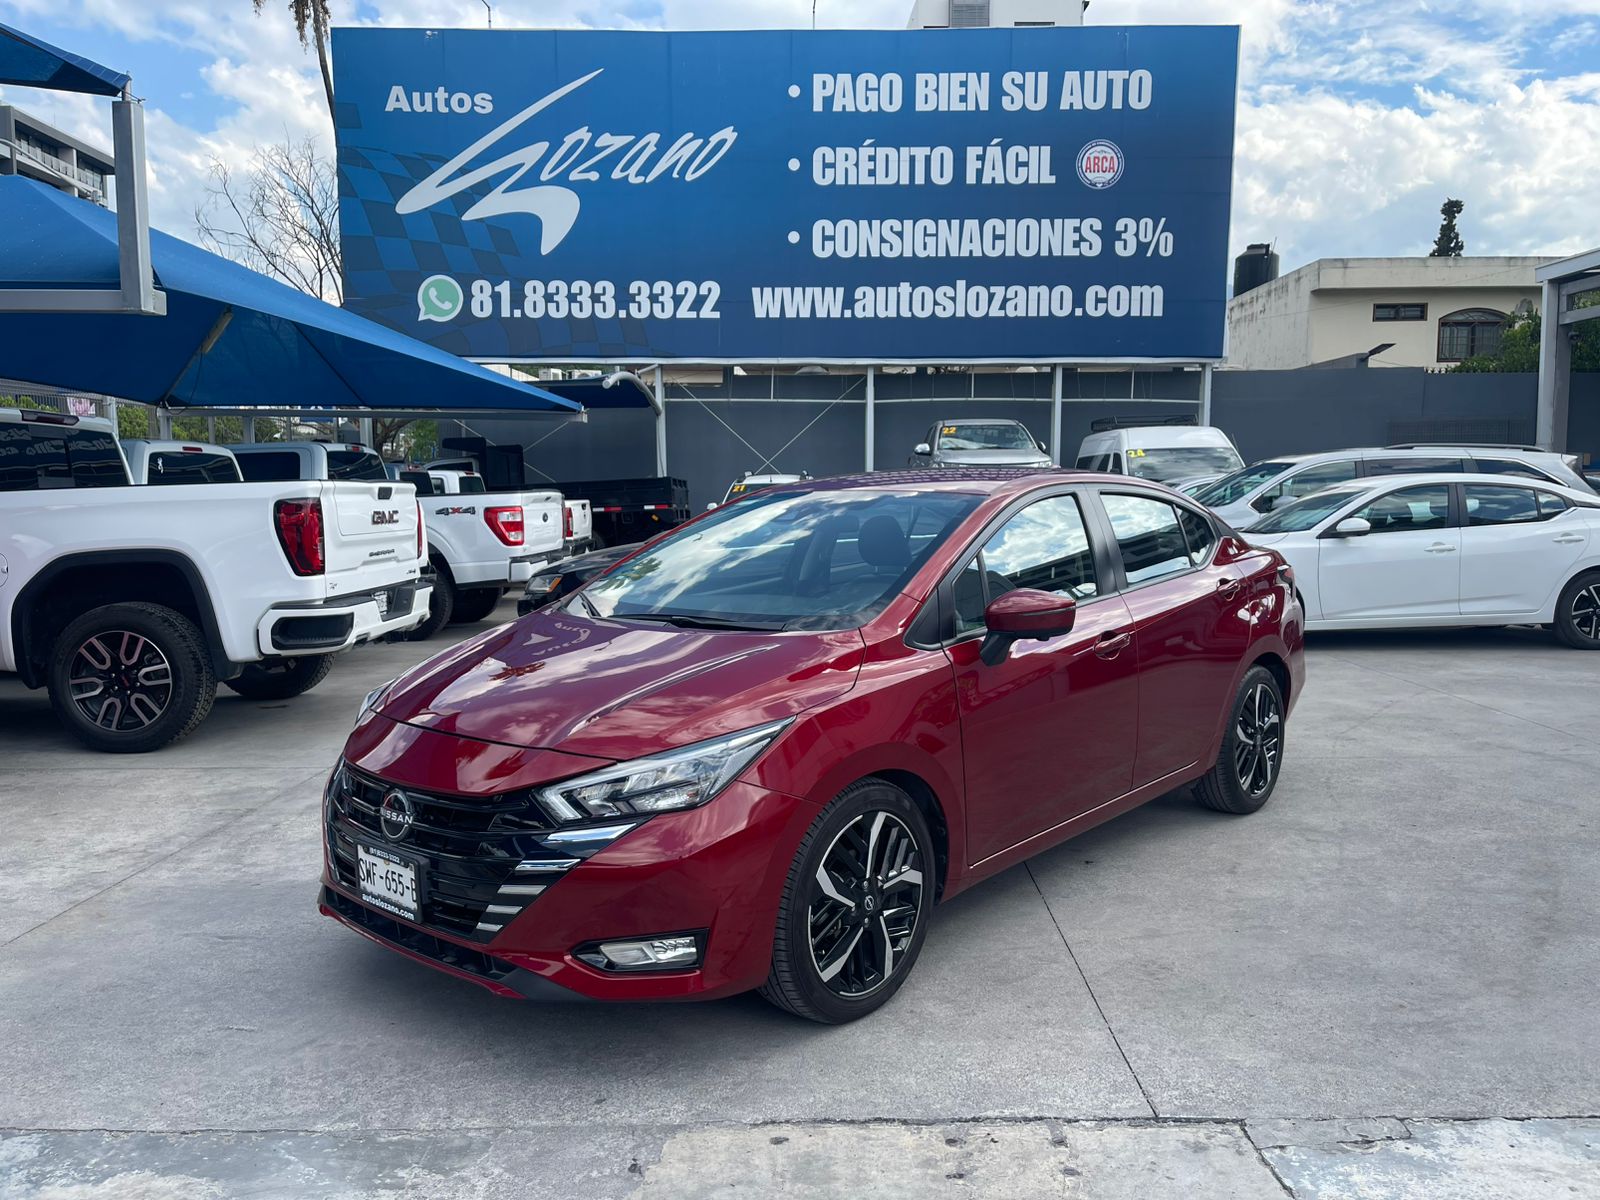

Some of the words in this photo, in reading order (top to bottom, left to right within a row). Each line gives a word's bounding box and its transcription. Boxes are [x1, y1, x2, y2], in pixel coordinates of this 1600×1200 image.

[385, 85, 494, 114] Autos
[812, 72, 903, 112] PAGO
[915, 72, 990, 112] BIEN
[1001, 71, 1049, 112] SU
[1059, 69, 1153, 111] AUTO
[394, 68, 738, 257] Lozano
[812, 138, 954, 186] CRÉDITO
[965, 138, 1056, 185] FÁCIL
[1084, 155, 1116, 174] ARCA
[812, 217, 1102, 258] CONSIGNACIONES
[1114, 217, 1174, 258] 3%
[470, 279, 721, 319] 81.8333.3322
[751, 279, 1164, 319] www.autoslozano.com
[942, 426, 957, 435] 22
[731, 484, 747, 494] 21
[371, 509, 400, 526] GMC
[380, 806, 414, 825] NISSAN
[361, 892, 416, 921] autoslozano.com
